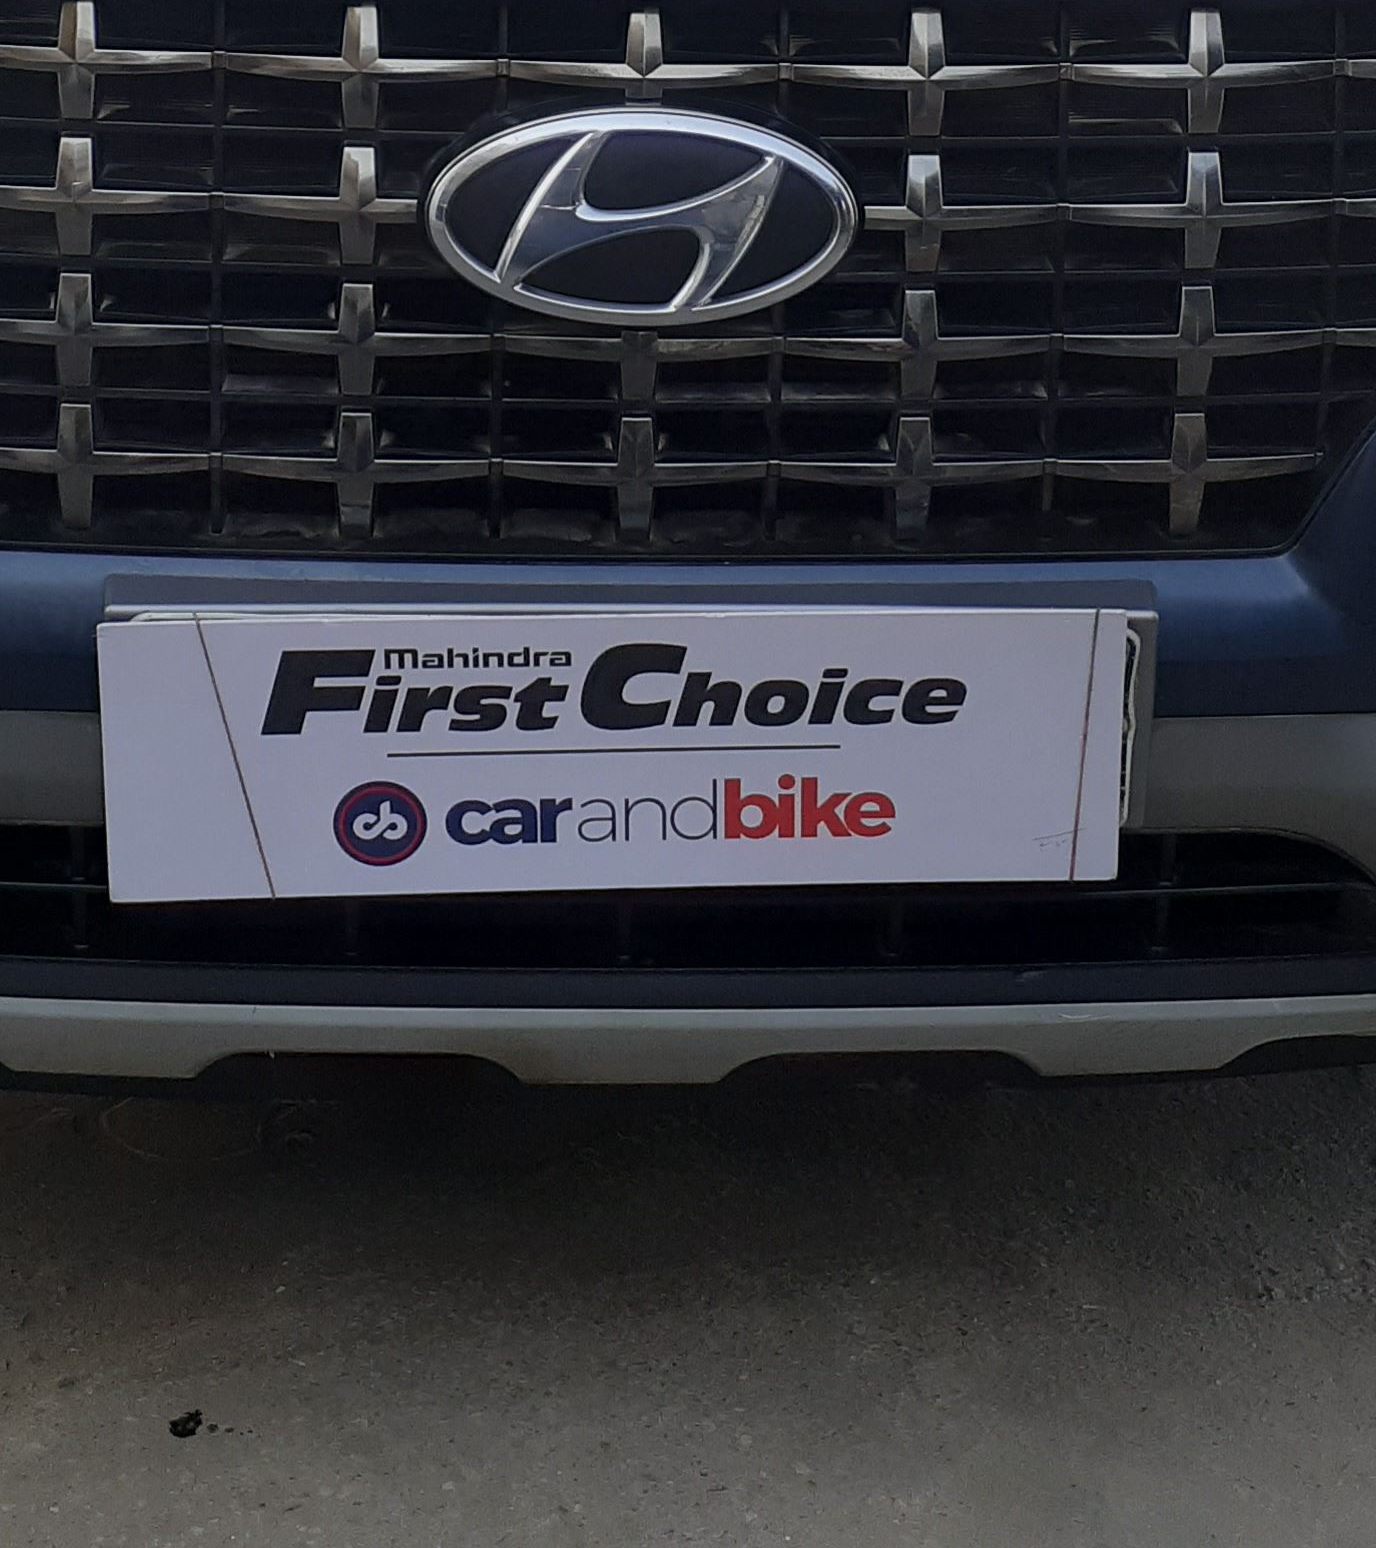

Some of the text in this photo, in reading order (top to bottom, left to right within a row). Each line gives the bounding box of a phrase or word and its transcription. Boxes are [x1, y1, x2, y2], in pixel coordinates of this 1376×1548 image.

[260, 642, 968, 736] First Choice
[383, 646, 573, 670] Mahindra
[445, 773, 897, 846] carandbike
